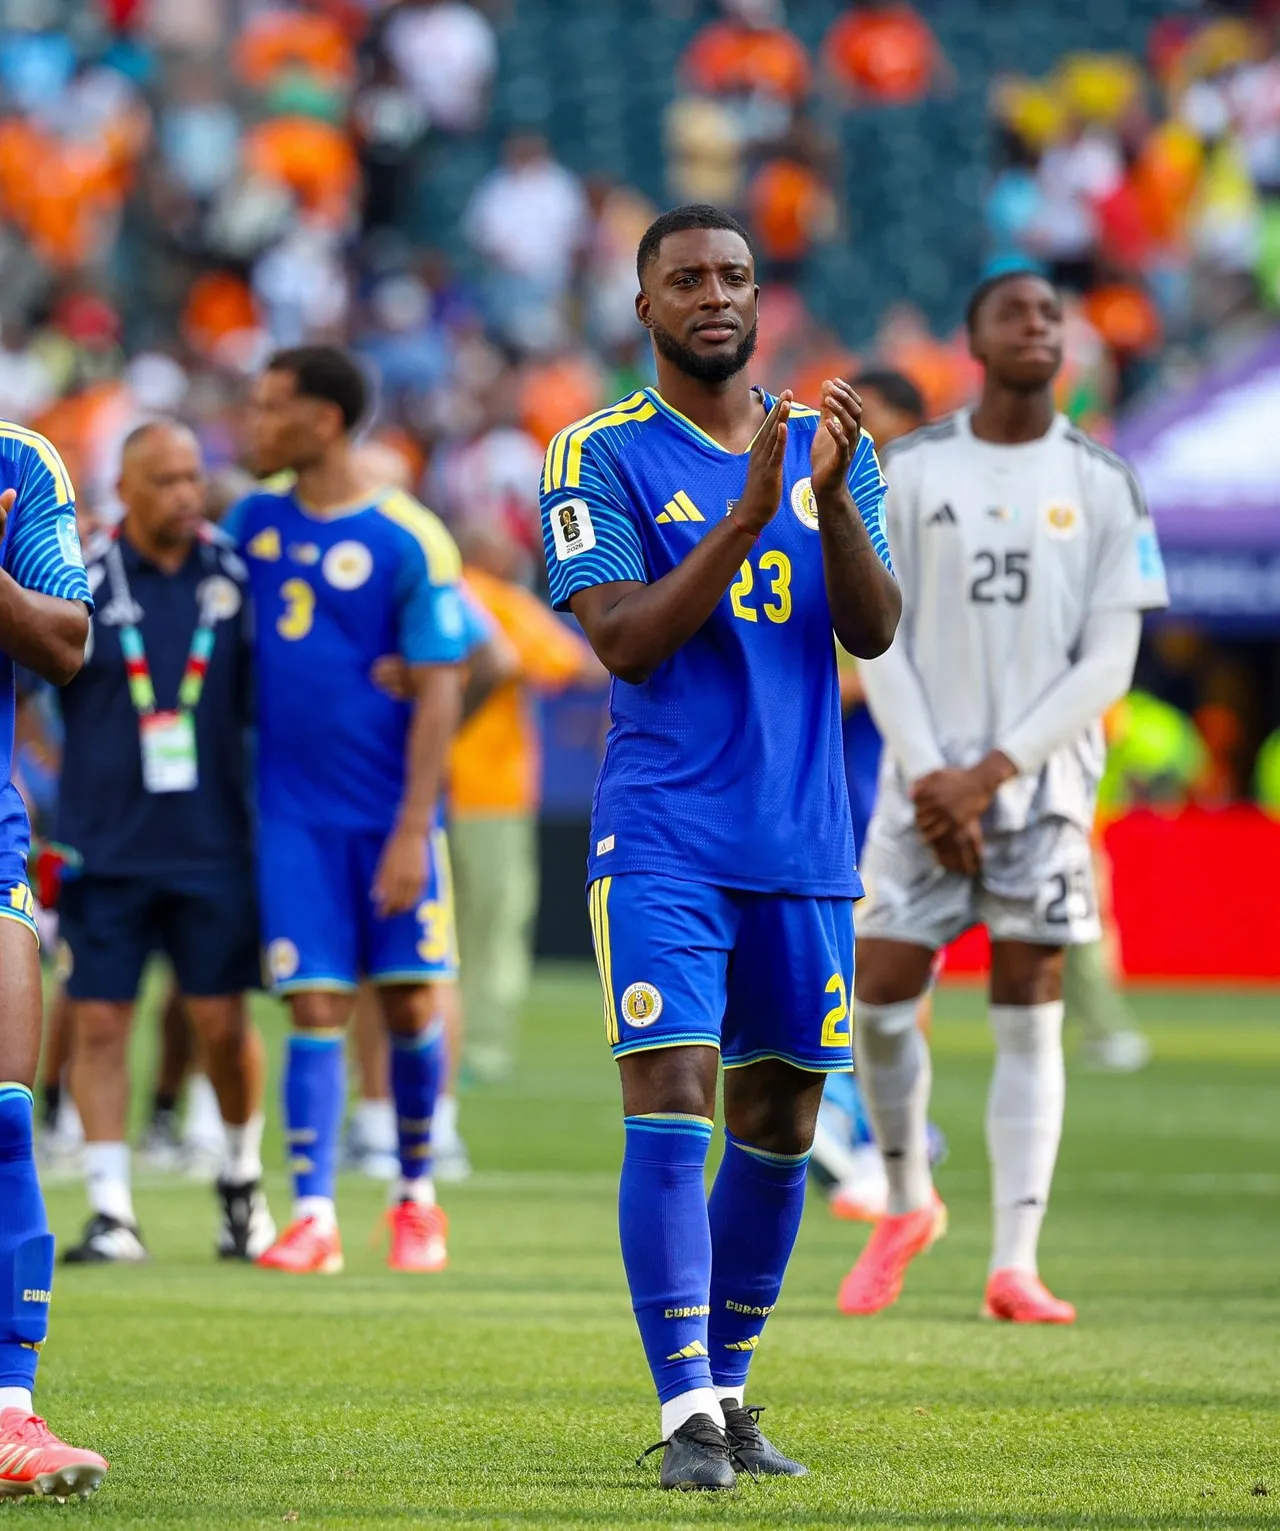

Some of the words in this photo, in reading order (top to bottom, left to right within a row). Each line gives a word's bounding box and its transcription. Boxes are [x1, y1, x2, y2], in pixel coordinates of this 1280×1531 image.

[277, 577, 317, 641] 3
[729, 550, 791, 624] 23
[969, 550, 1028, 606] 25
[417, 901, 450, 963] 3
[23, 1288, 52, 1304] CURA
